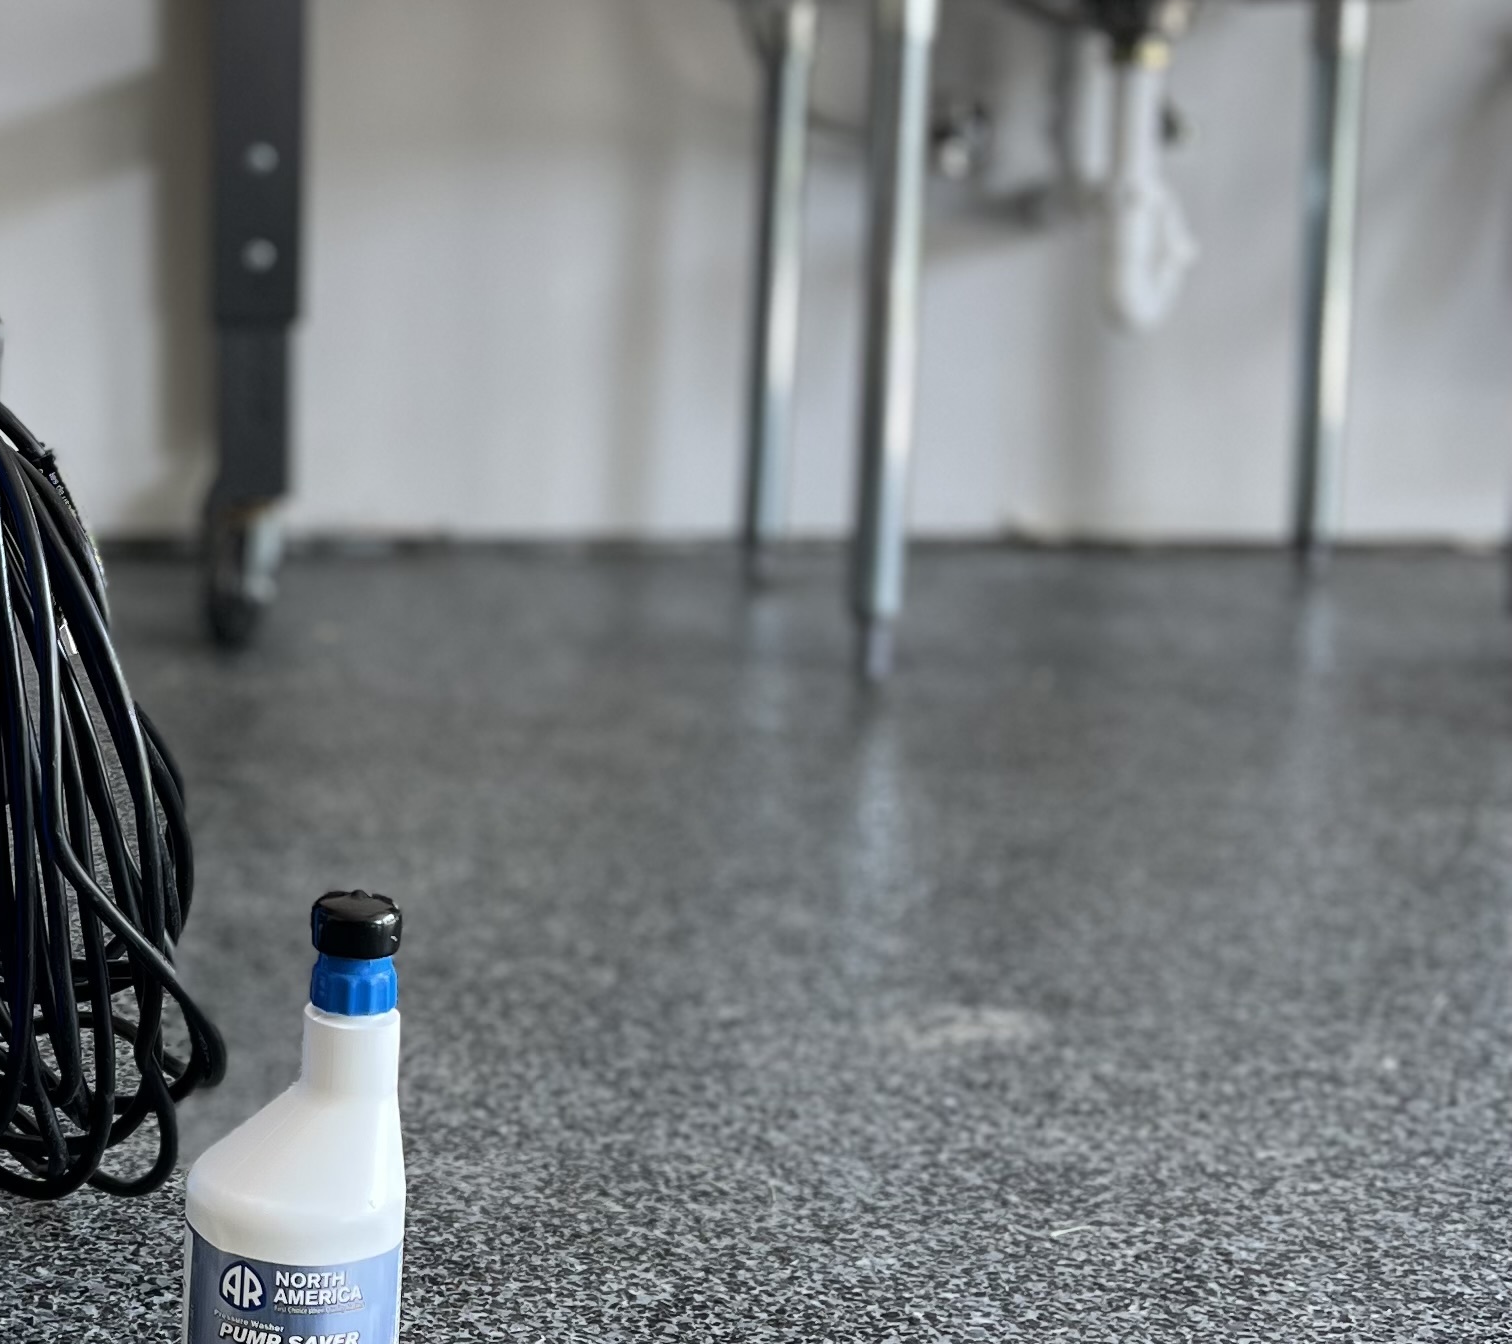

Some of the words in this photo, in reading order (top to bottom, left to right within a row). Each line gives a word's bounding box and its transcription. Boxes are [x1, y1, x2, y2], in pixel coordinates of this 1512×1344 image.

[220, 1262, 266, 1311] AR
[275, 1270, 347, 1290] NORTH
[273, 1286, 364, 1306] AMERICA
[250, 1318, 286, 1334] Washer
